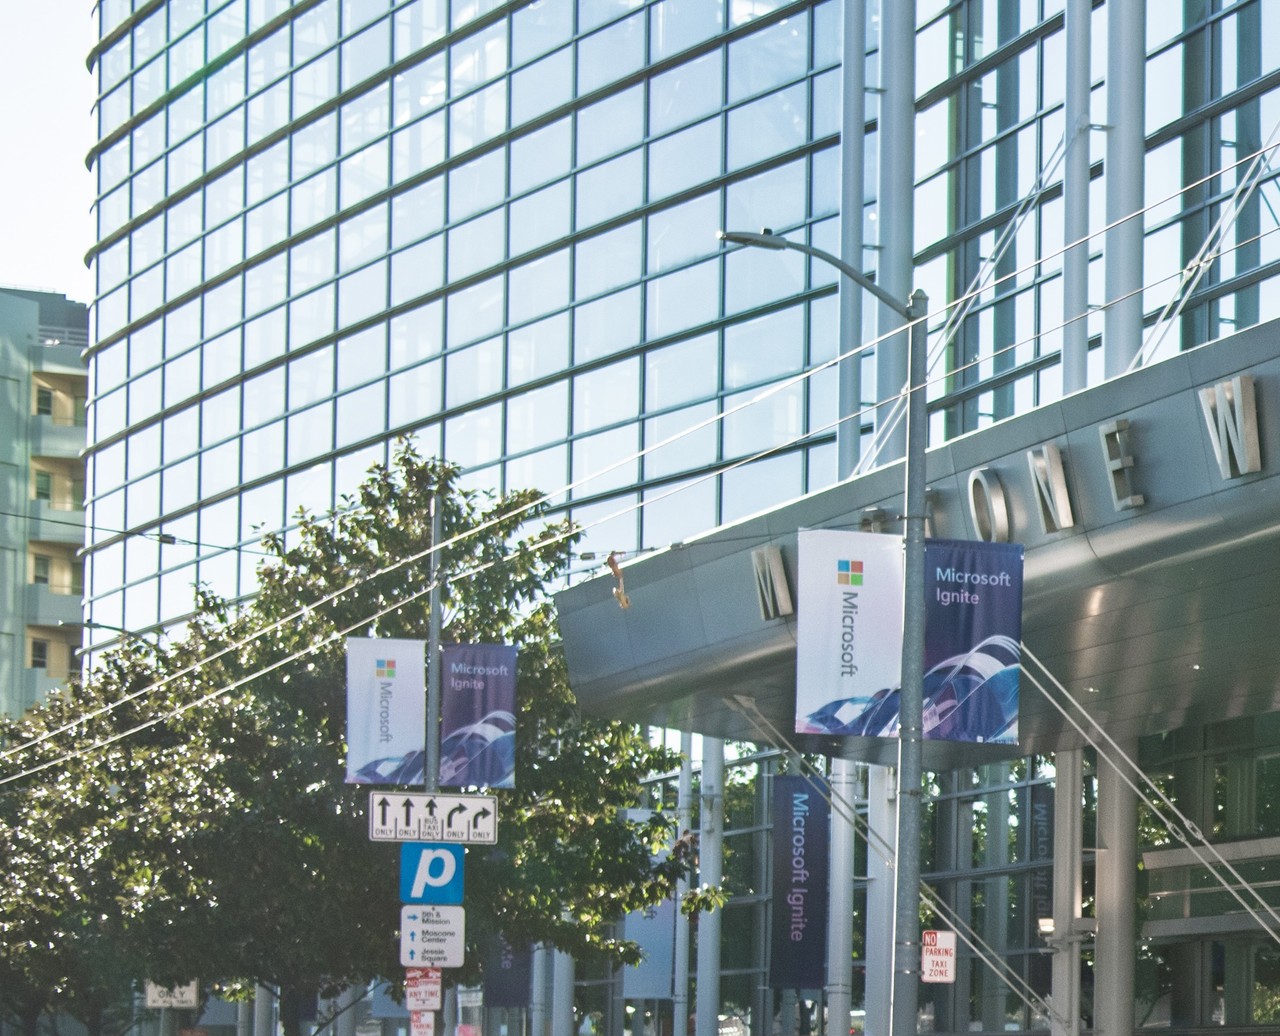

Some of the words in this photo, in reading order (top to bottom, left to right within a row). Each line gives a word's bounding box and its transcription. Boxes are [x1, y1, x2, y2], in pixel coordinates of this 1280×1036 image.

[751, 418, 1146, 621] MONE
[936, 568, 1012, 588] Microsoft
[936, 588, 981, 606] Ignite
[841, 591, 859, 677] Microsoft
[451, 663, 509, 676] Microsoft
[451, 677, 485, 690] Ignite
[379, 682, 393, 743] Microsoft
[792, 793, 810, 883] Microsoft
[787, 888, 808, 942] Ignite
